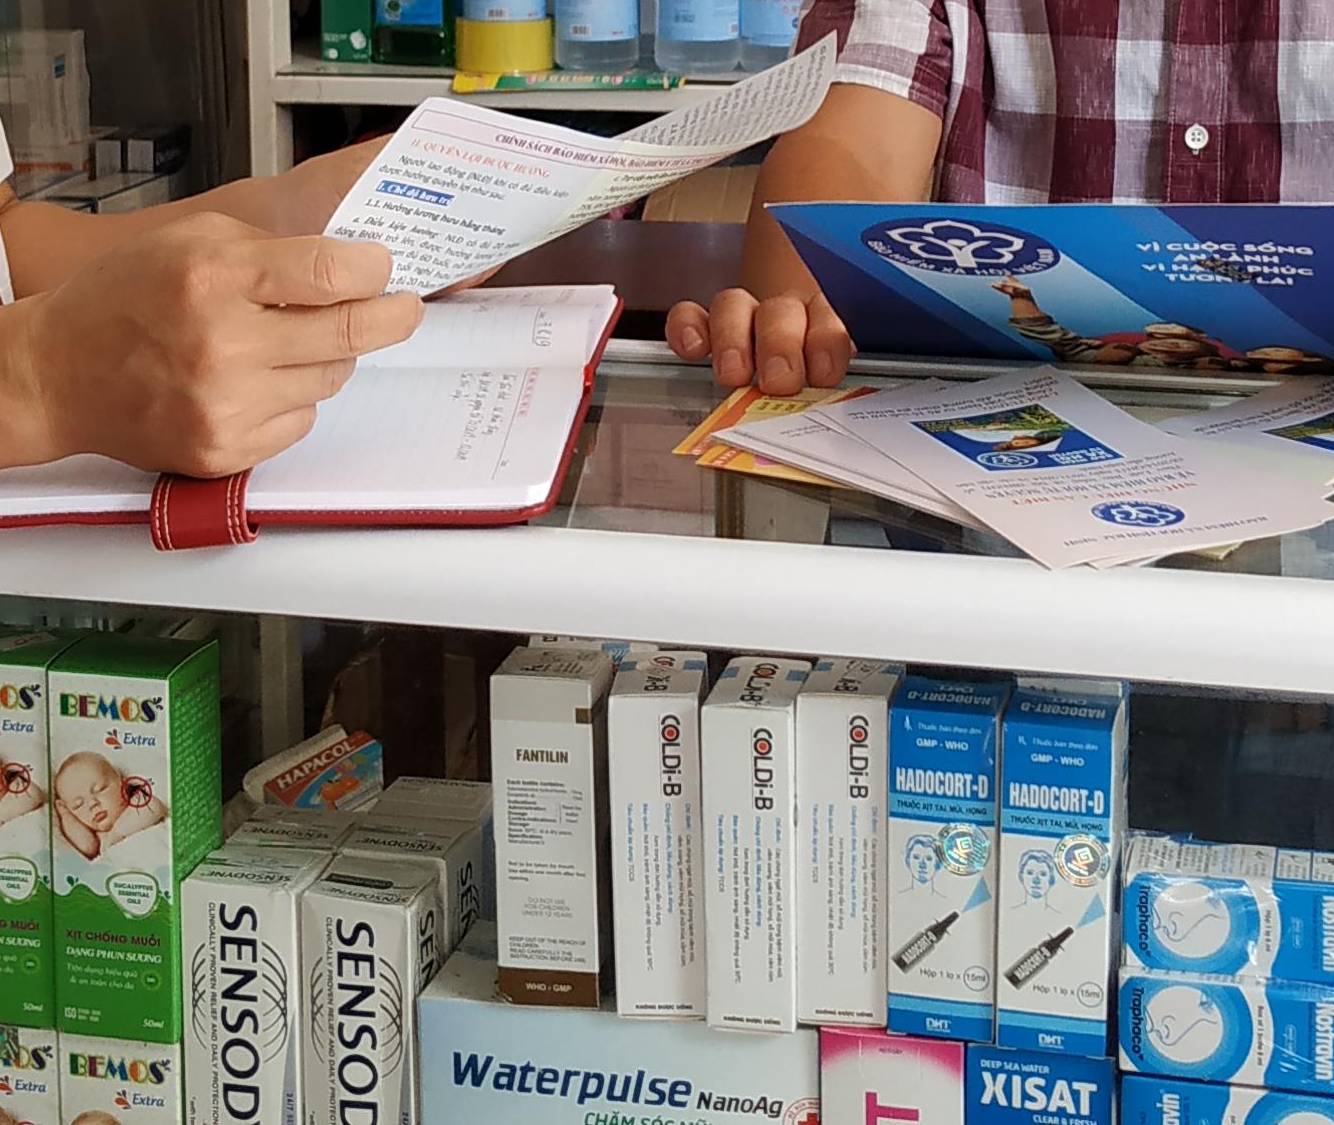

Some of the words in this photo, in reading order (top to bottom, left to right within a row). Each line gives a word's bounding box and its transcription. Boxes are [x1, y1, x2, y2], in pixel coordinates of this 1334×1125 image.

[495, 133, 526, 149] CHÍNH
[527, 140, 553, 154] SÁCH
[1166, 241, 1237, 253] CUỘC
[1243, 241, 1315, 256] SỐNG
[1173, 253, 1207, 263] AN
[1247, 264, 1315, 276] PHÚC
[1256, 276, 1294, 286] LAI
[59, 692, 158, 724] BEMOS
[2, 720, 34, 733] Extra
[123, 733, 156, 747] Extra
[916, 737, 938, 748] GMP
[946, 740, 969, 751] WHO
[516, 749, 569, 764] FANTILIN
[1031, 753, 1053, 764] GMP
[1060, 756, 1084, 767] WHO
[276, 740, 356, 790] HAPACOL
[896, 766, 989, 800] HADOCORT-D
[1009, 782, 1104, 815] HADOCORT-D
[1011, 814, 1036, 825] THUỐC
[1137, 885, 1152, 953] Traphaco
[208, 902, 216, 952] CLINICALLY
[86, 929, 128, 944] CHỐNG
[66, 946, 95, 958] DẠNG
[96, 948, 125, 960] PHUN
[126, 951, 163, 964] SƯƠNG
[209, 954, 217, 990] PROVEN
[966, 972, 987, 983] 15ml
[525, 982, 547, 992] WHO
[553, 984, 573, 993] GMP
[1080, 988, 1101, 999] 15ml
[23, 1002, 44, 1013] 50ml
[219, 903, 261, 1125] SENSOD
[143, 1018, 164, 1029] 50ml
[1130, 987, 1145, 1055] Traphaco
[211, 1045, 219, 1071] DAILY
[69, 1051, 168, 1085] BEMOS
[980, 1059, 1002, 1069] DEEP
[1004, 1062, 1020, 1071] SEA
[1021, 1063, 1050, 1074] WATER
[14, 1079, 47, 1093] Extra
[452, 1051, 693, 1108] Waterpulse
[696, 1092, 784, 1118] NanoAg
[132, 1093, 165, 1107] Extra
[212, 1073, 220, 1125] PROTECTION
[981, 1072, 1098, 1116] XISAT
